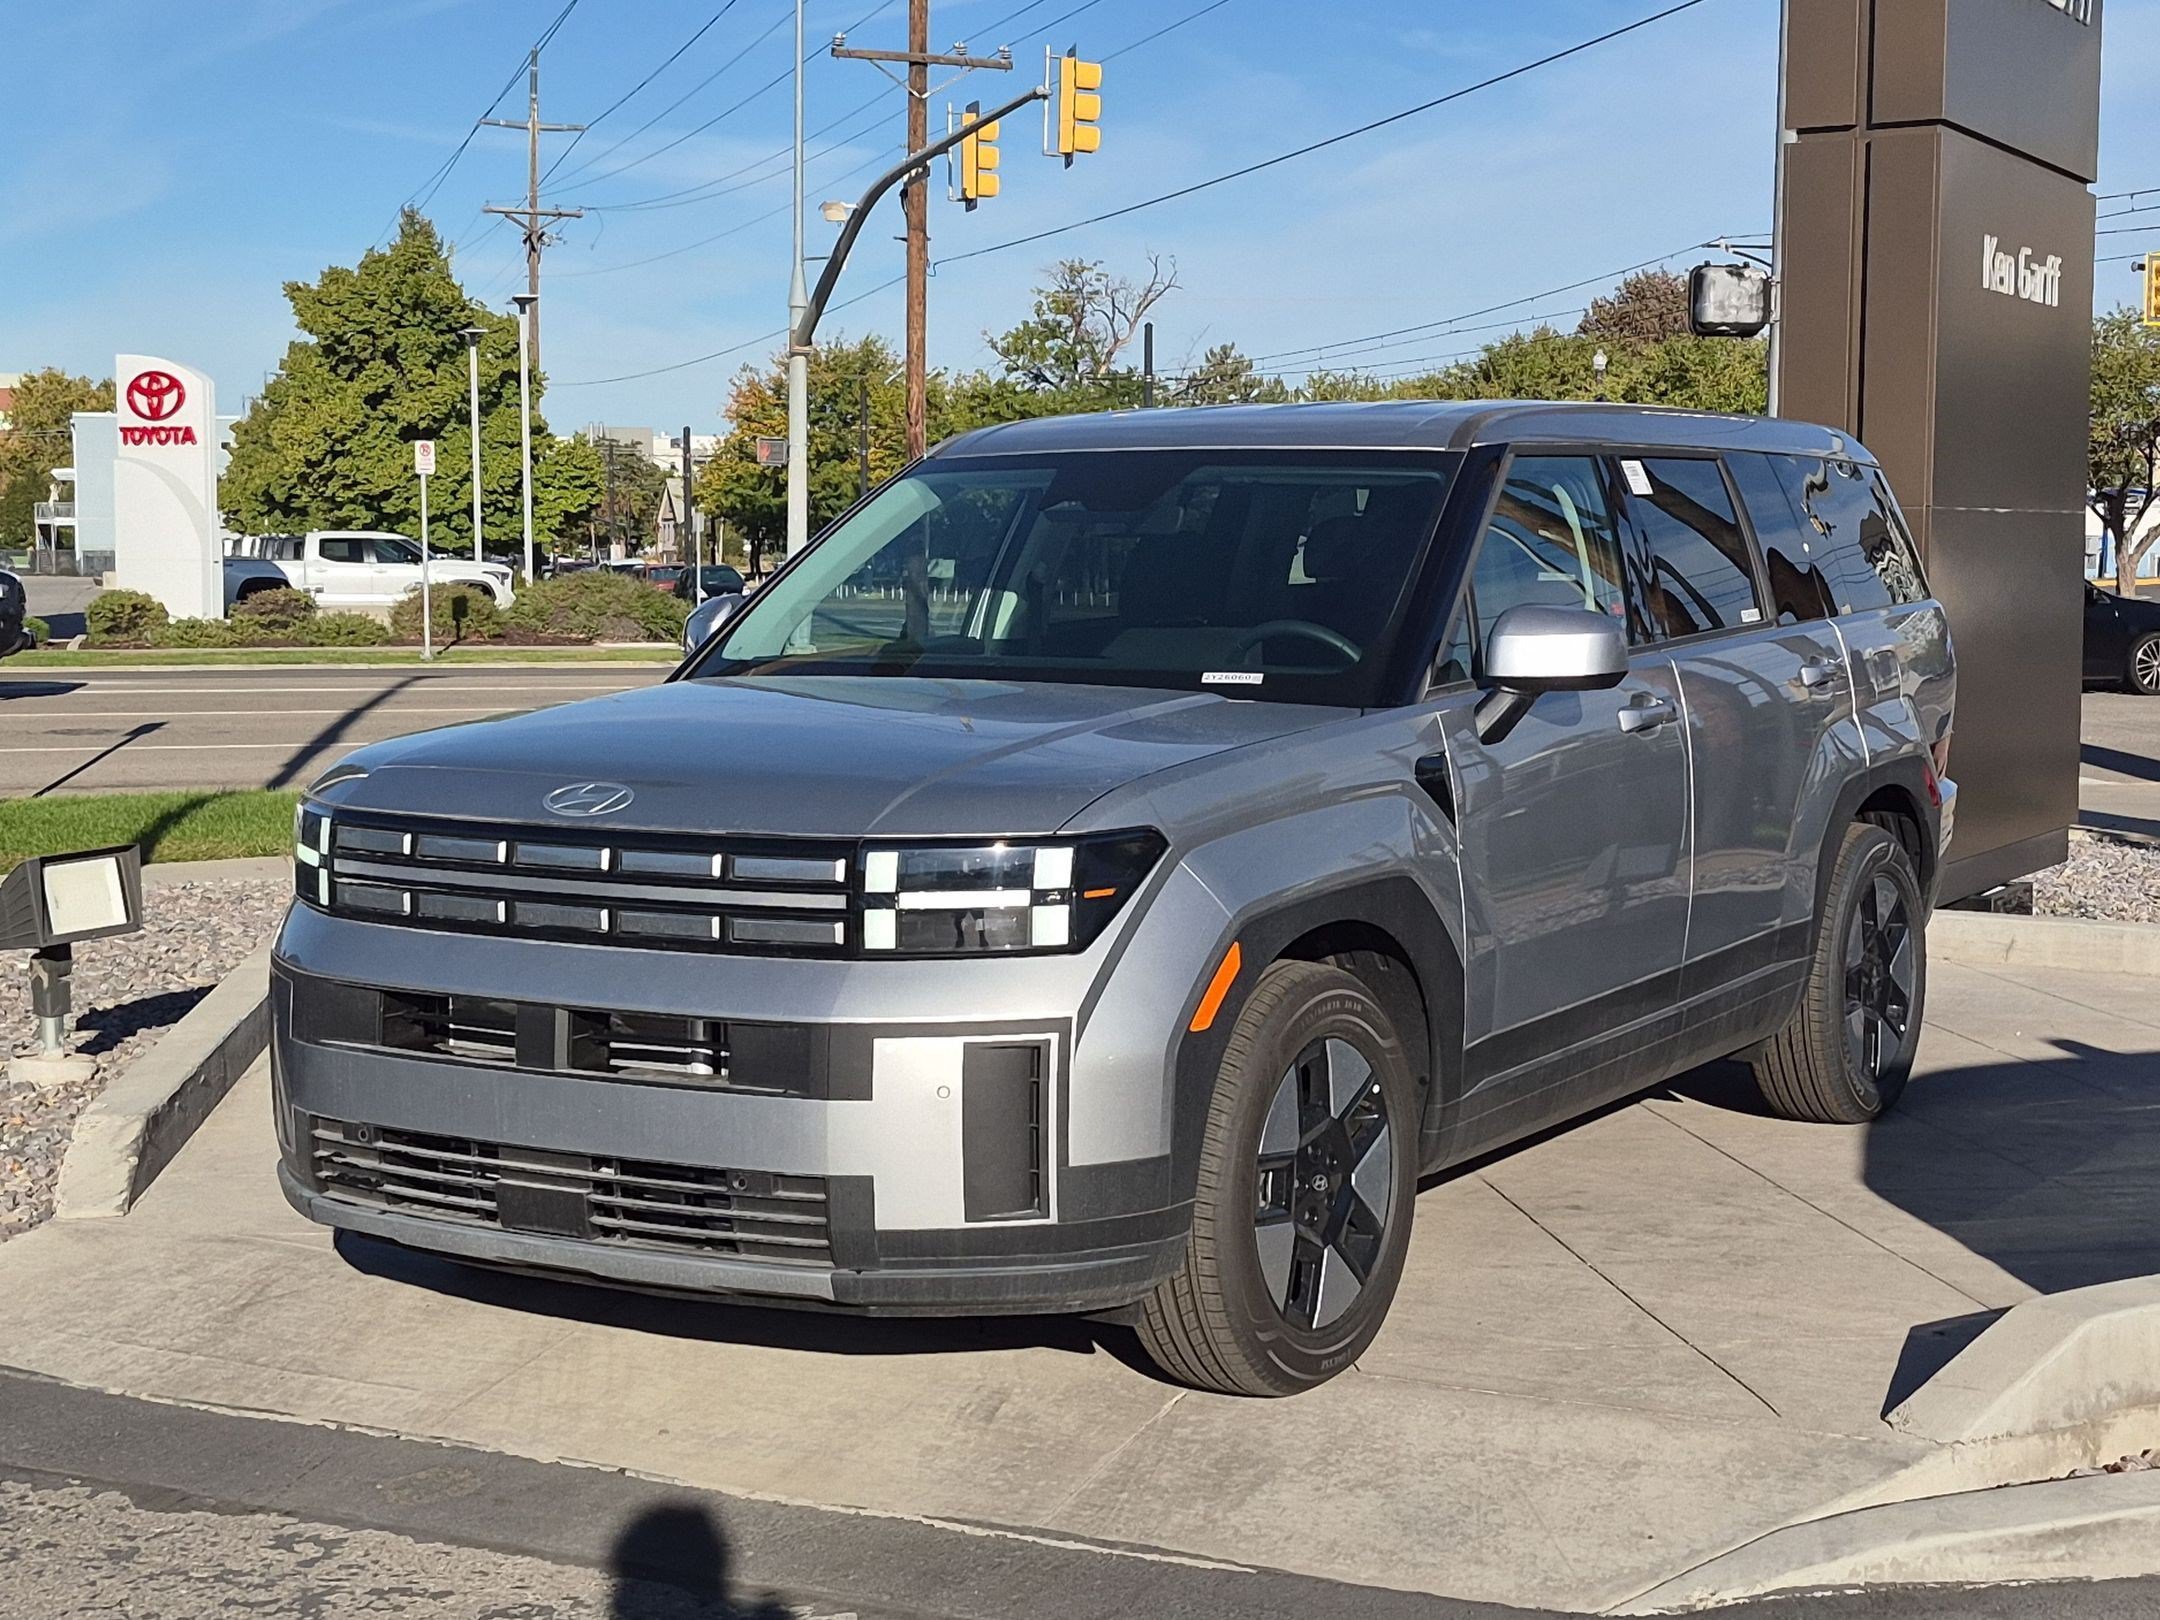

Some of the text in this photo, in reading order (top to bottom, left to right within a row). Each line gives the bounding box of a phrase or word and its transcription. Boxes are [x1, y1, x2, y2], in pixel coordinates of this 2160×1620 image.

[1983, 234, 2062, 307] Ken Garff
[119, 426, 197, 446] TOYOTA
